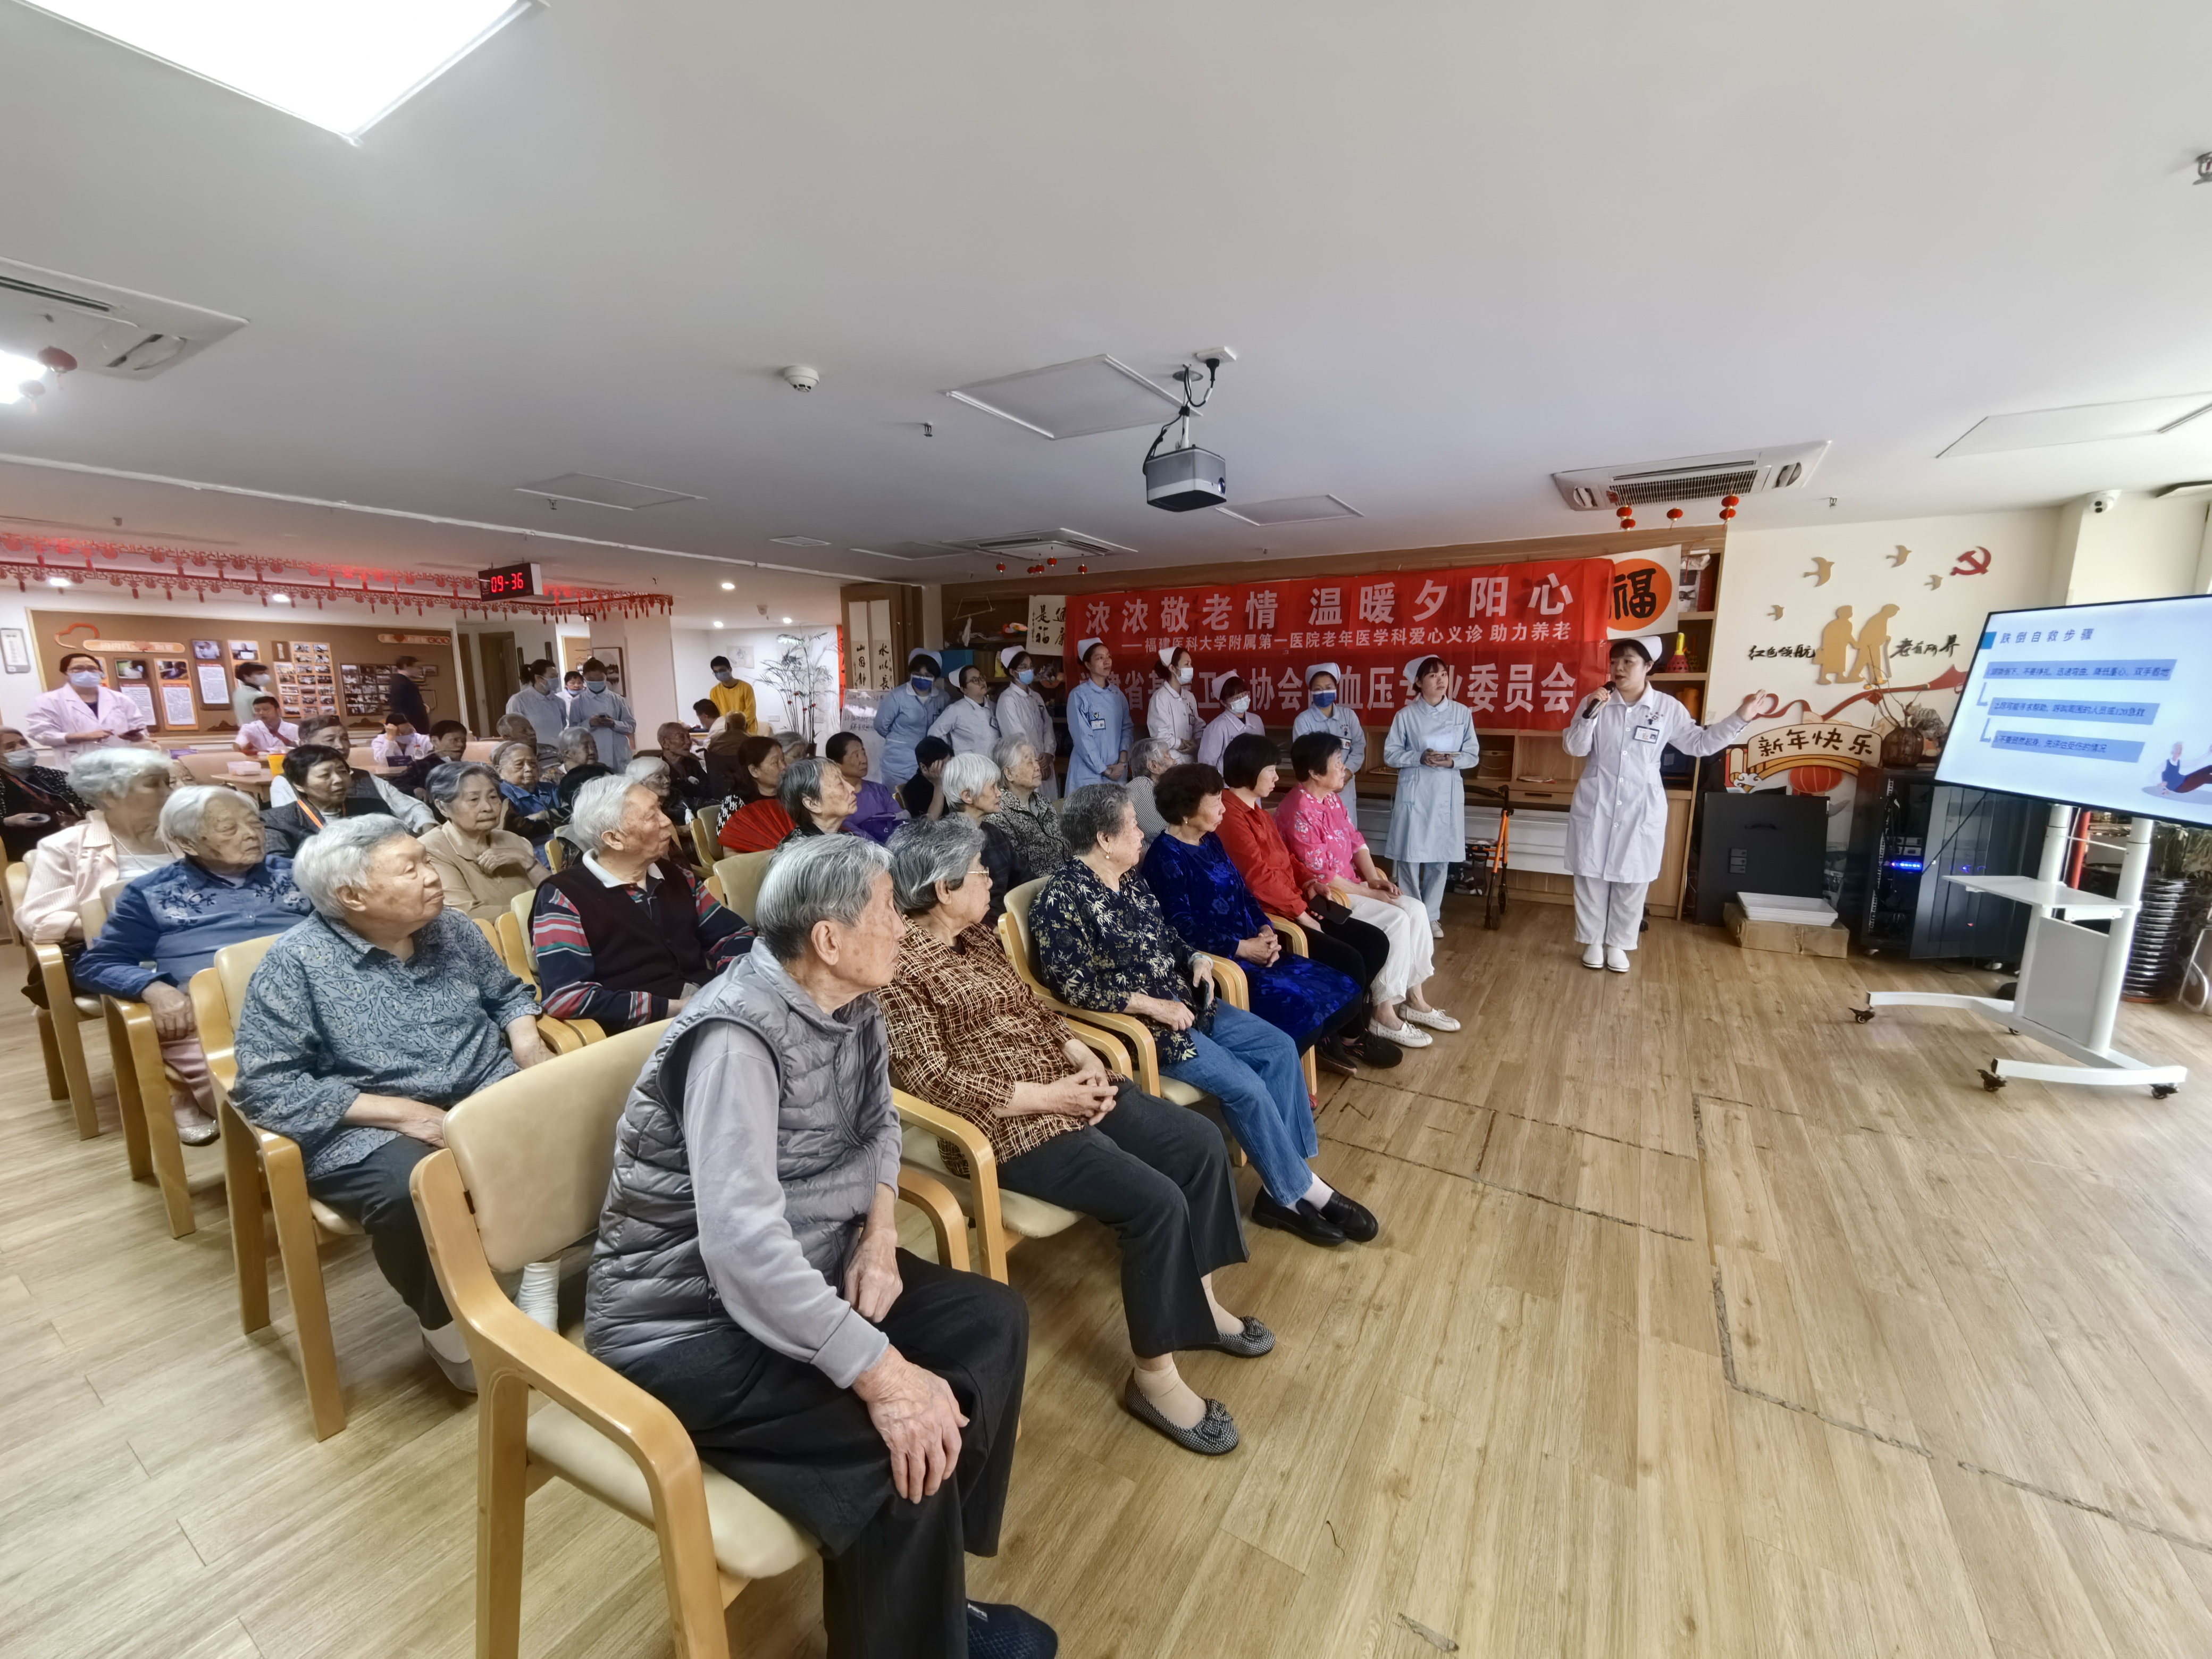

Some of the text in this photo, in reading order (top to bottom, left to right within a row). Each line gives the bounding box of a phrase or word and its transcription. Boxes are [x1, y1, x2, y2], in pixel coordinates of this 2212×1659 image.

[1085, 590, 1278, 634] 浓浓敬老情
[1309, 573, 1573, 626] 温暖夕阳心
[1609, 568, 1656, 621] 福
[1489, 621, 1572, 642] 助力养老
[1999, 628, 2094, 644] 跌倒自救步骤
[1747, 644, 1816, 660] 红色领航
[1758, 727, 1872, 757] 新年快乐
